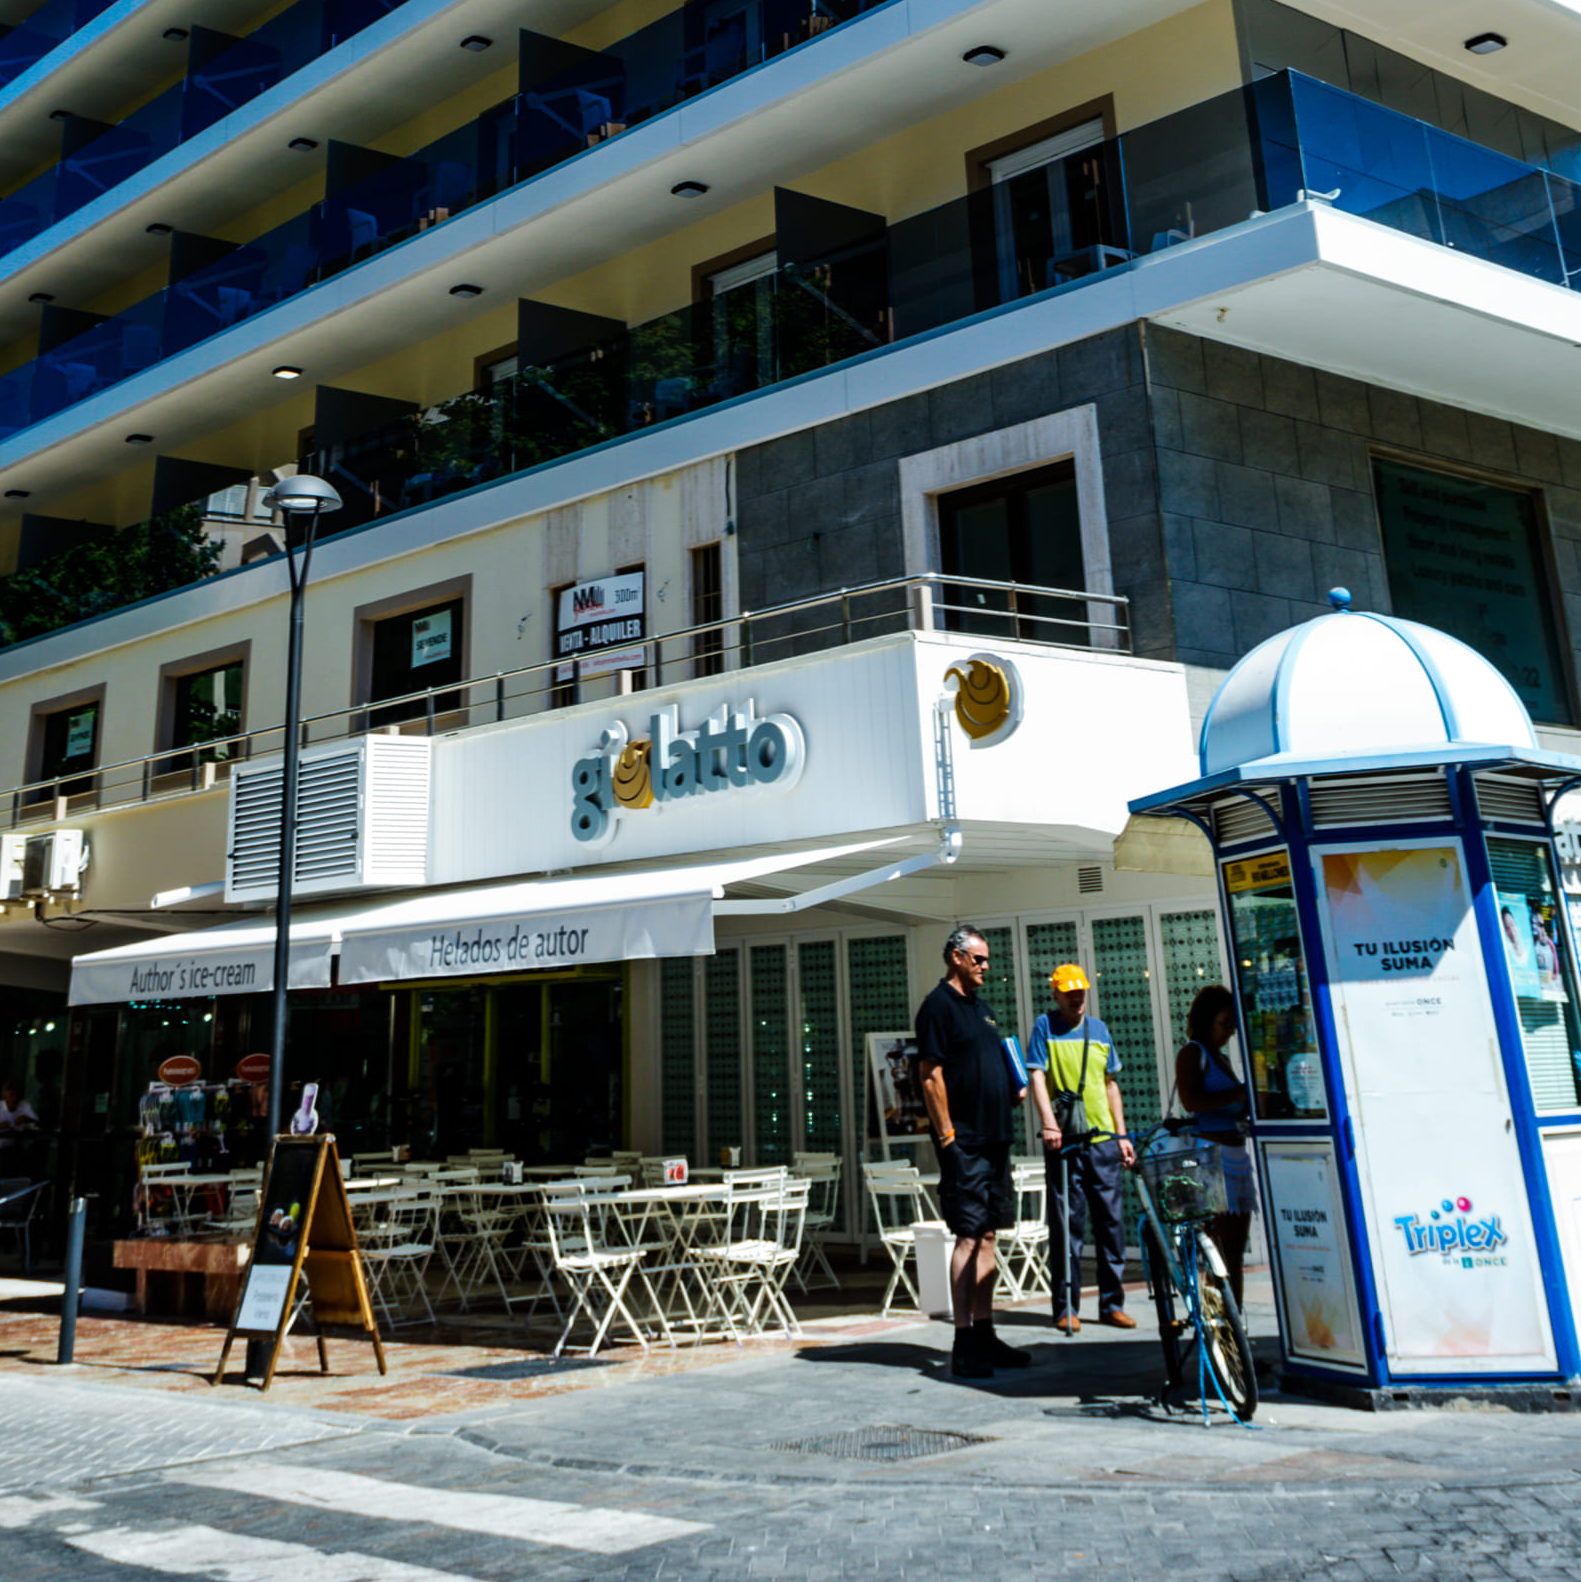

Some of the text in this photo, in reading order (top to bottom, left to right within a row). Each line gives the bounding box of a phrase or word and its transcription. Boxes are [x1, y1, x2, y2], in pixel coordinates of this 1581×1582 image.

[430, 924, 589, 968] Helados de autor
[1353, 936, 1455, 956] TU ILUSIÓN
[1381, 956, 1434, 971] SUMA
[188, 960, 256, 989] ice-cream
[1416, 997, 1442, 1006] ONCE
[1394, 1213, 1506, 1255] Triplex
[1475, 1256, 1507, 1267] ONCE
